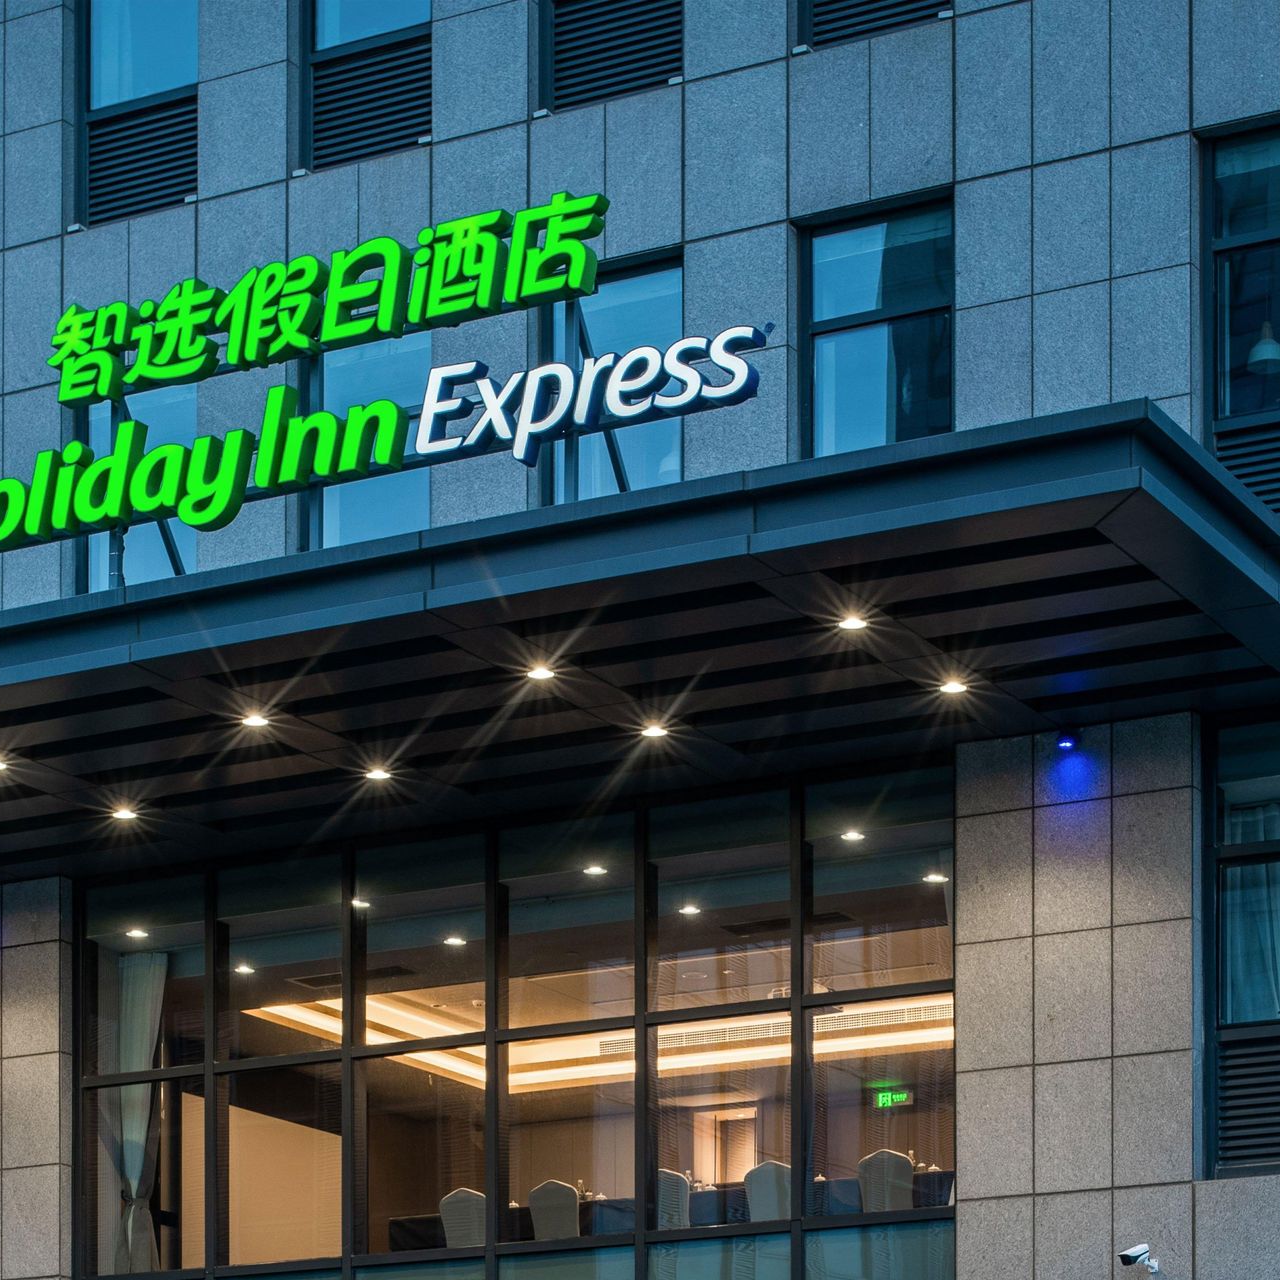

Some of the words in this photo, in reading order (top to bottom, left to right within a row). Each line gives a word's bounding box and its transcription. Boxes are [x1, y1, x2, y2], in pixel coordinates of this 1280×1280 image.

[46, 191, 607, 404] 智选假日酒店
[254, 384, 406, 488] Inn
[415, 325, 764, 464] Express
